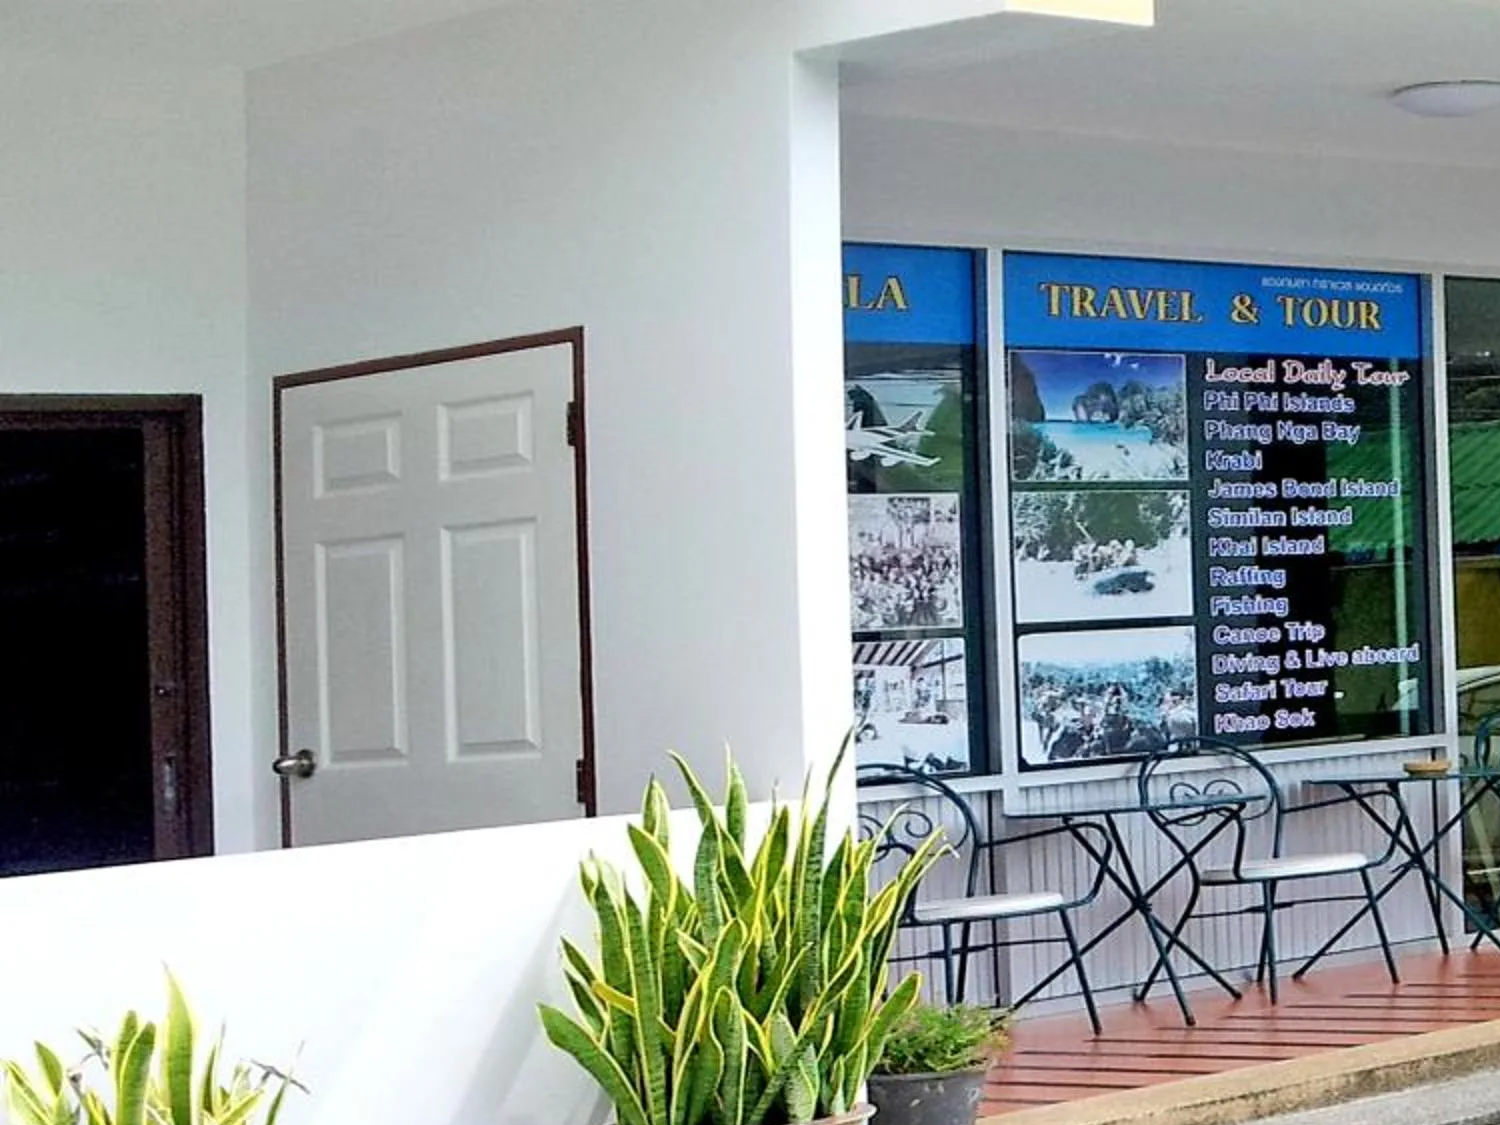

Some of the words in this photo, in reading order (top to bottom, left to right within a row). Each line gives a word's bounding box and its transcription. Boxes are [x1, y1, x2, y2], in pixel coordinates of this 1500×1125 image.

[1039, 282, 1203, 323] TRAVEL
[1230, 292, 1260, 324] &
[1277, 295, 1382, 329] TOUR
[1206, 358, 1276, 383] Local
[1282, 358, 1346, 391] Daily
[1351, 361, 1410, 386] Tour
[1203, 390, 1239, 411] Phi
[1243, 391, 1278, 412] Phi
[1282, 392, 1355, 413] Islands
[1204, 420, 1272, 444] Phang
[1277, 420, 1319, 444] Nga
[1322, 421, 1360, 446] Bay
[1205, 450, 1262, 470] Krabi
[1208, 478, 1277, 498] James
[1281, 478, 1336, 497] Bond
[1340, 478, 1400, 496] Island
[1208, 507, 1286, 527] Similan
[1290, 506, 1352, 525] Island
[1209, 537, 1257, 556] Khai
[1262, 535, 1325, 555] Island
[1209, 566, 1286, 588] Rafting
[1210, 595, 1288, 617] Fishing
[1213, 625, 1281, 644] Canoe
[1285, 621, 1325, 643] Trip
[1212, 653, 1280, 675] Diving
[1284, 650, 1301, 669] &
[1305, 648, 1348, 668] Live
[1352, 643, 1420, 665] aboard
[1215, 680, 1277, 702] Safari
[1280, 679, 1328, 698] Tour
[1214, 713, 1271, 734] Khao
[1274, 708, 1315, 728] Sok
